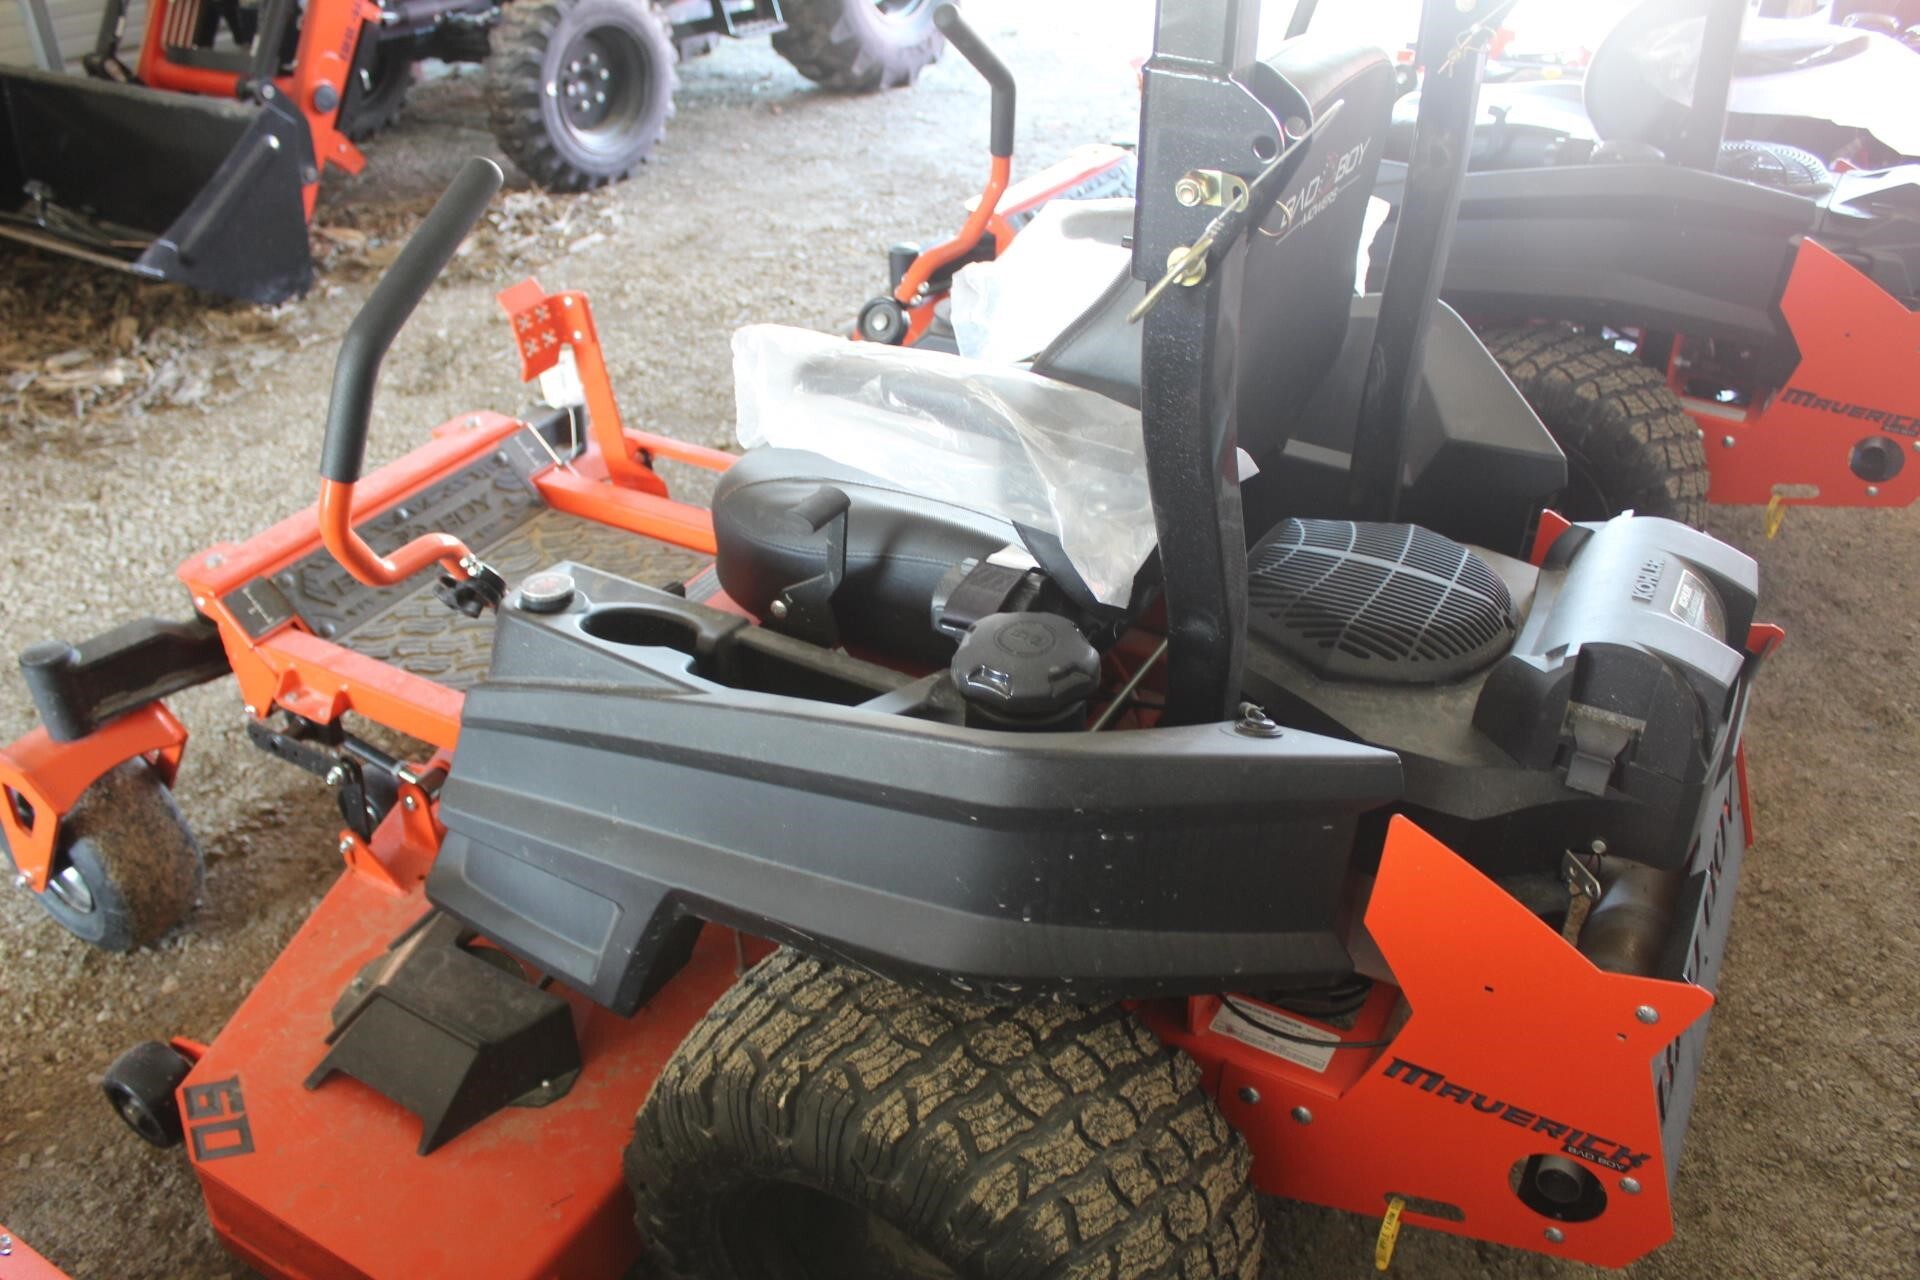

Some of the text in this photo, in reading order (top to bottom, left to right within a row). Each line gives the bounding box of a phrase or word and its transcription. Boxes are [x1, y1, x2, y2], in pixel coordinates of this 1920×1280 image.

[1281, 136, 1371, 229] BAD BOY
[1631, 558, 1666, 604] KOHLER
[182, 1074, 256, 1162] 60
[1382, 1056, 1651, 1168] MAVERICK
[1567, 1145, 1626, 1172] BAD BOY
